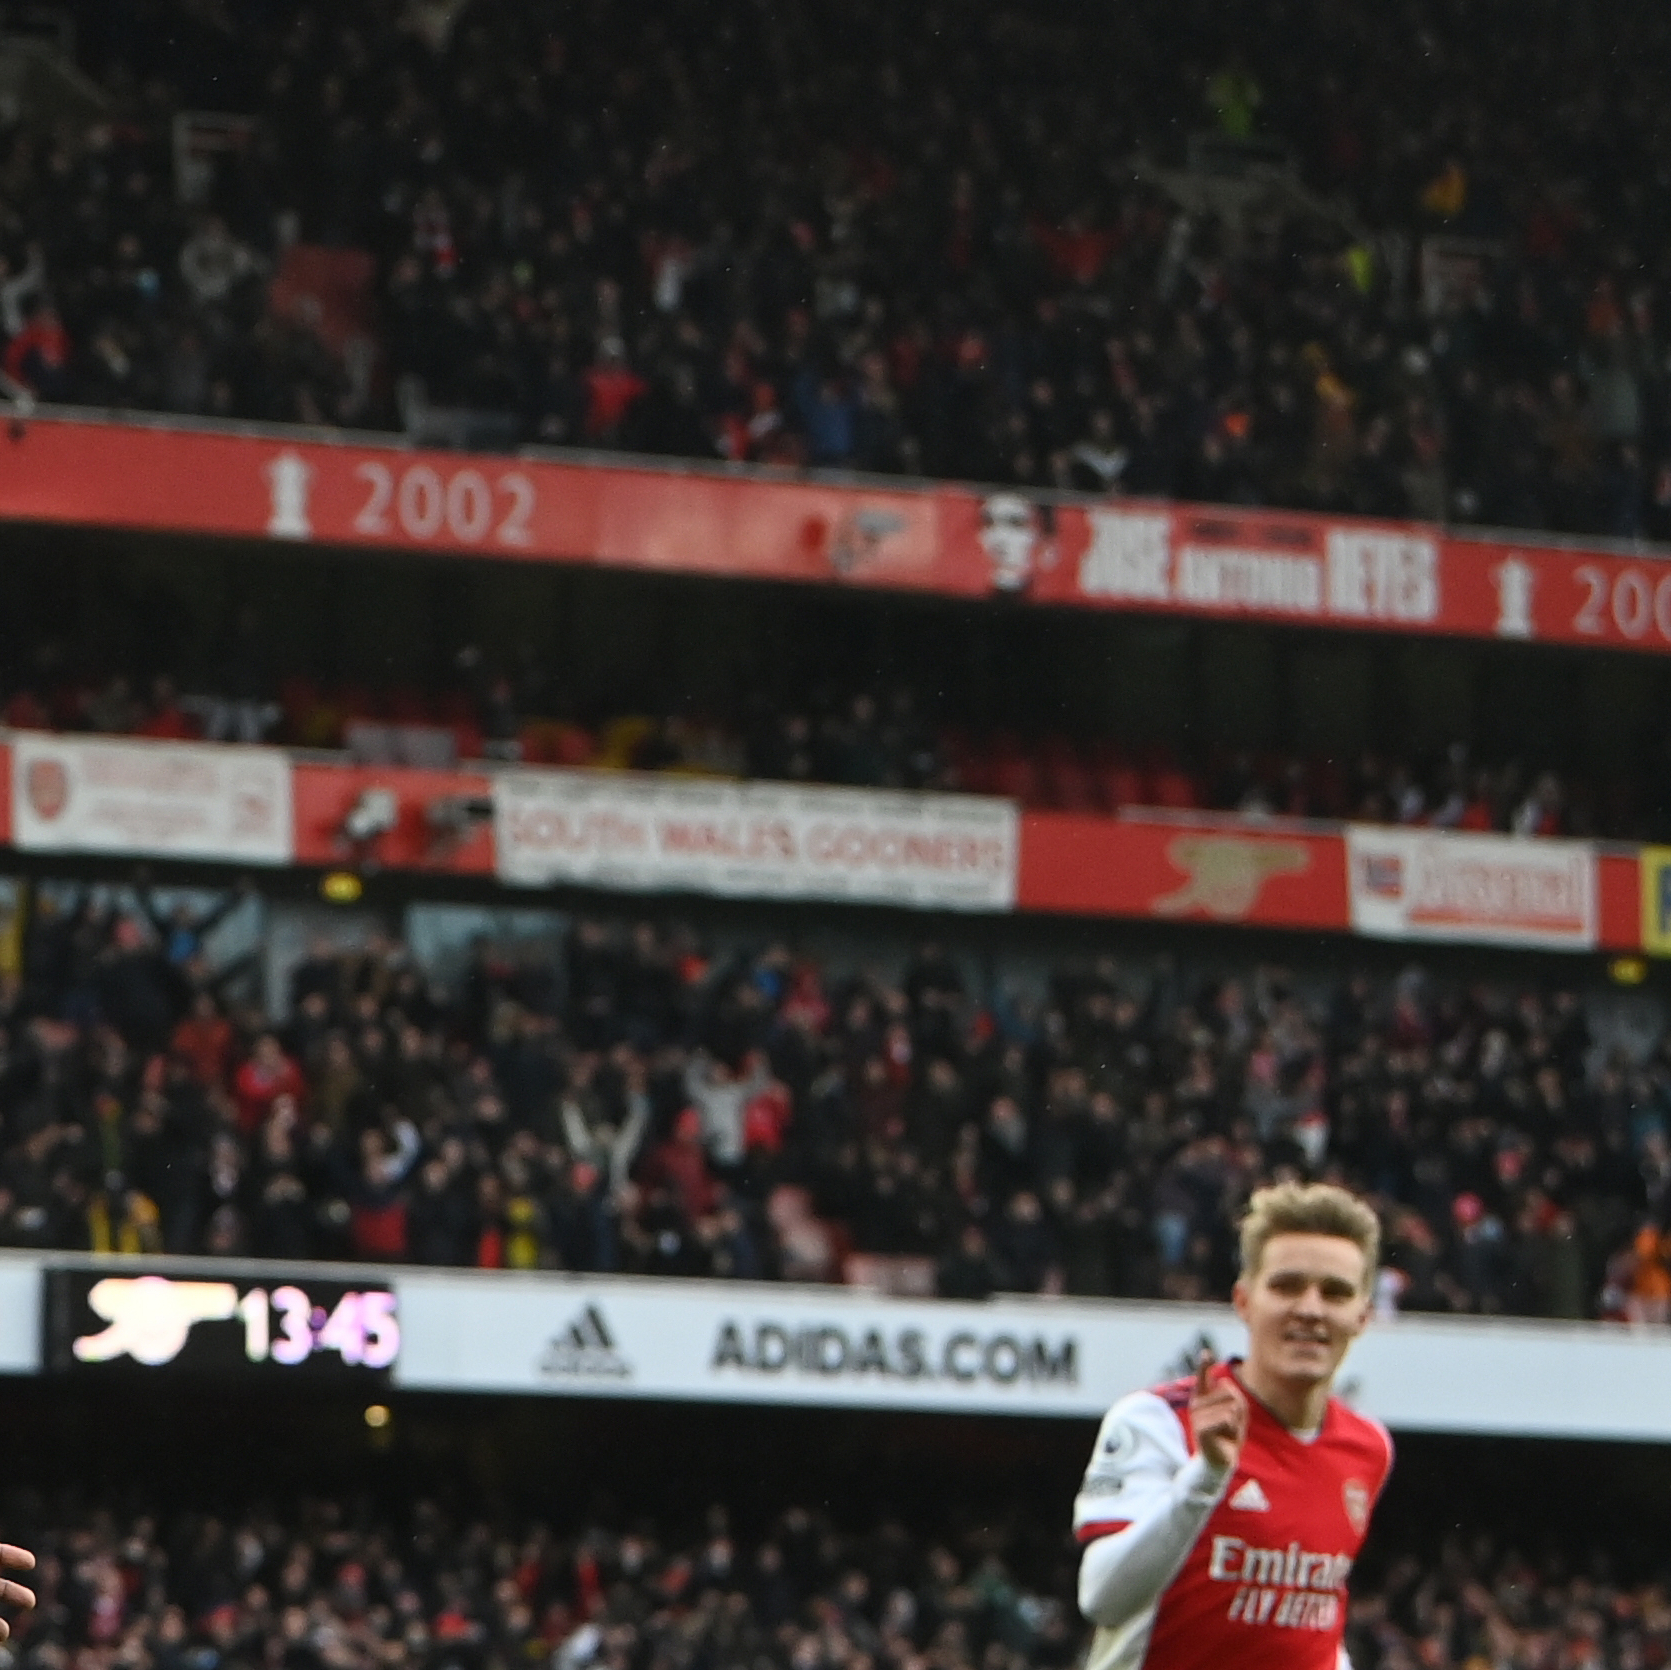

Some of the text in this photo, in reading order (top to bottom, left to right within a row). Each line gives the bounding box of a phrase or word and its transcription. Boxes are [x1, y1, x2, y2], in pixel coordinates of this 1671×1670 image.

[352, 461, 536, 548] 2002
[239, 1285, 401, 1369] 13:45
[711, 1319, 1078, 1386] ADIDAS.COM
